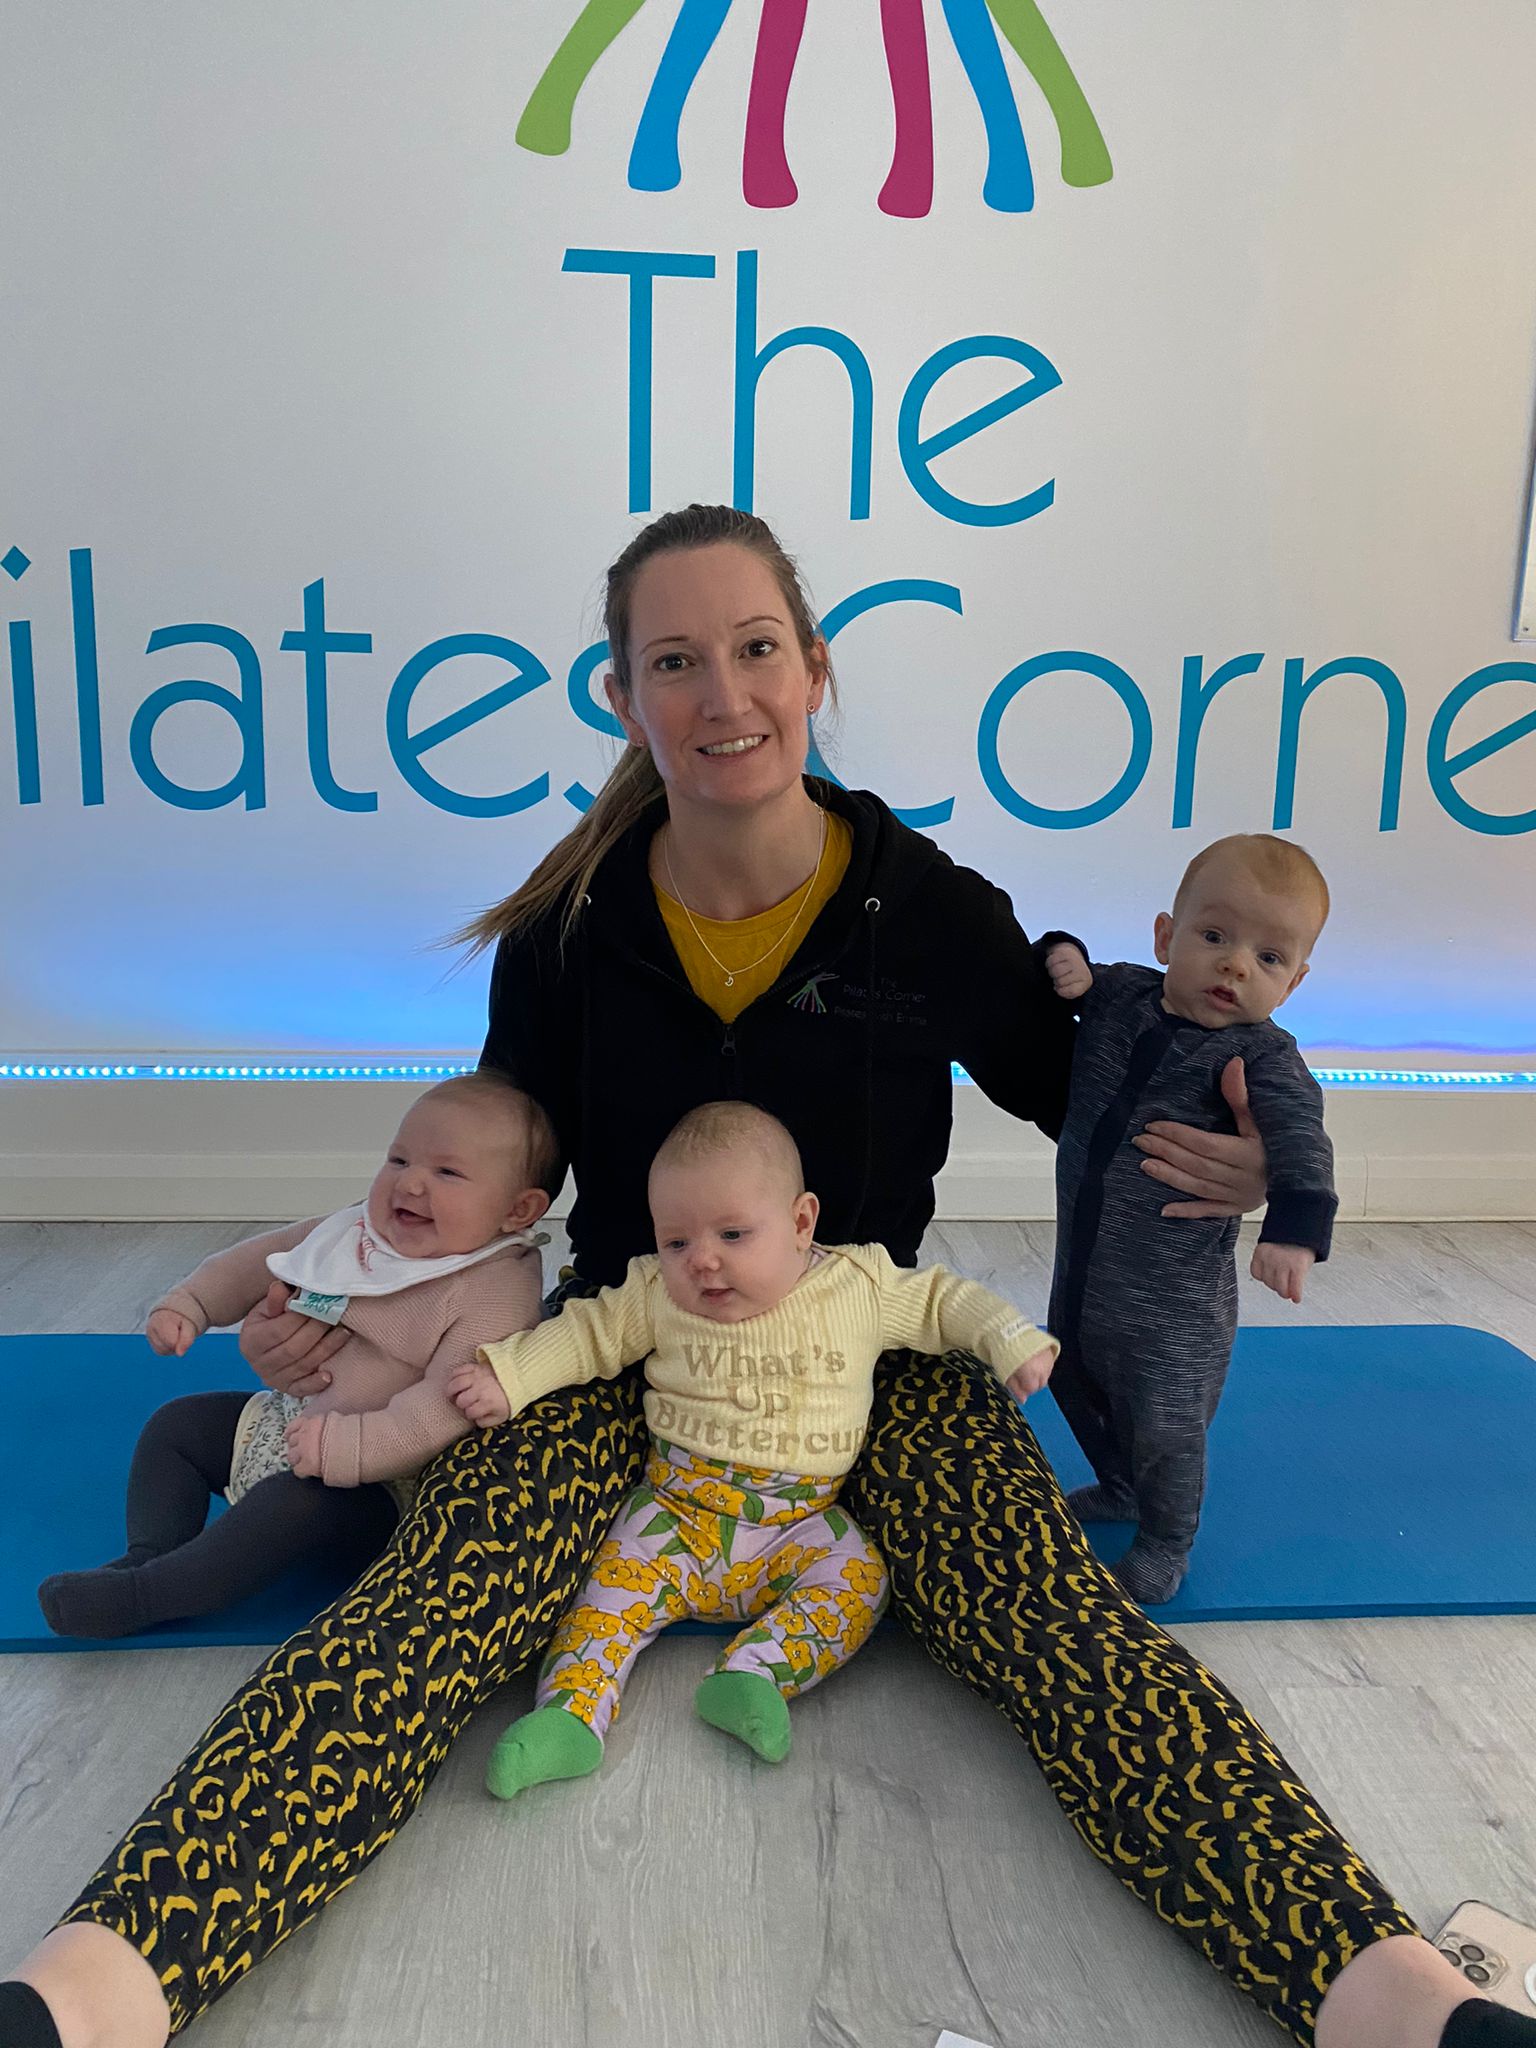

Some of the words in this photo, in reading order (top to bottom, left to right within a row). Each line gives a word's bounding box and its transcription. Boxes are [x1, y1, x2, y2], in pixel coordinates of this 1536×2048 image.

[562, 249, 1062, 526] The
[682, 1344, 846, 1378] What's
[727, 1384, 792, 1418] Up
